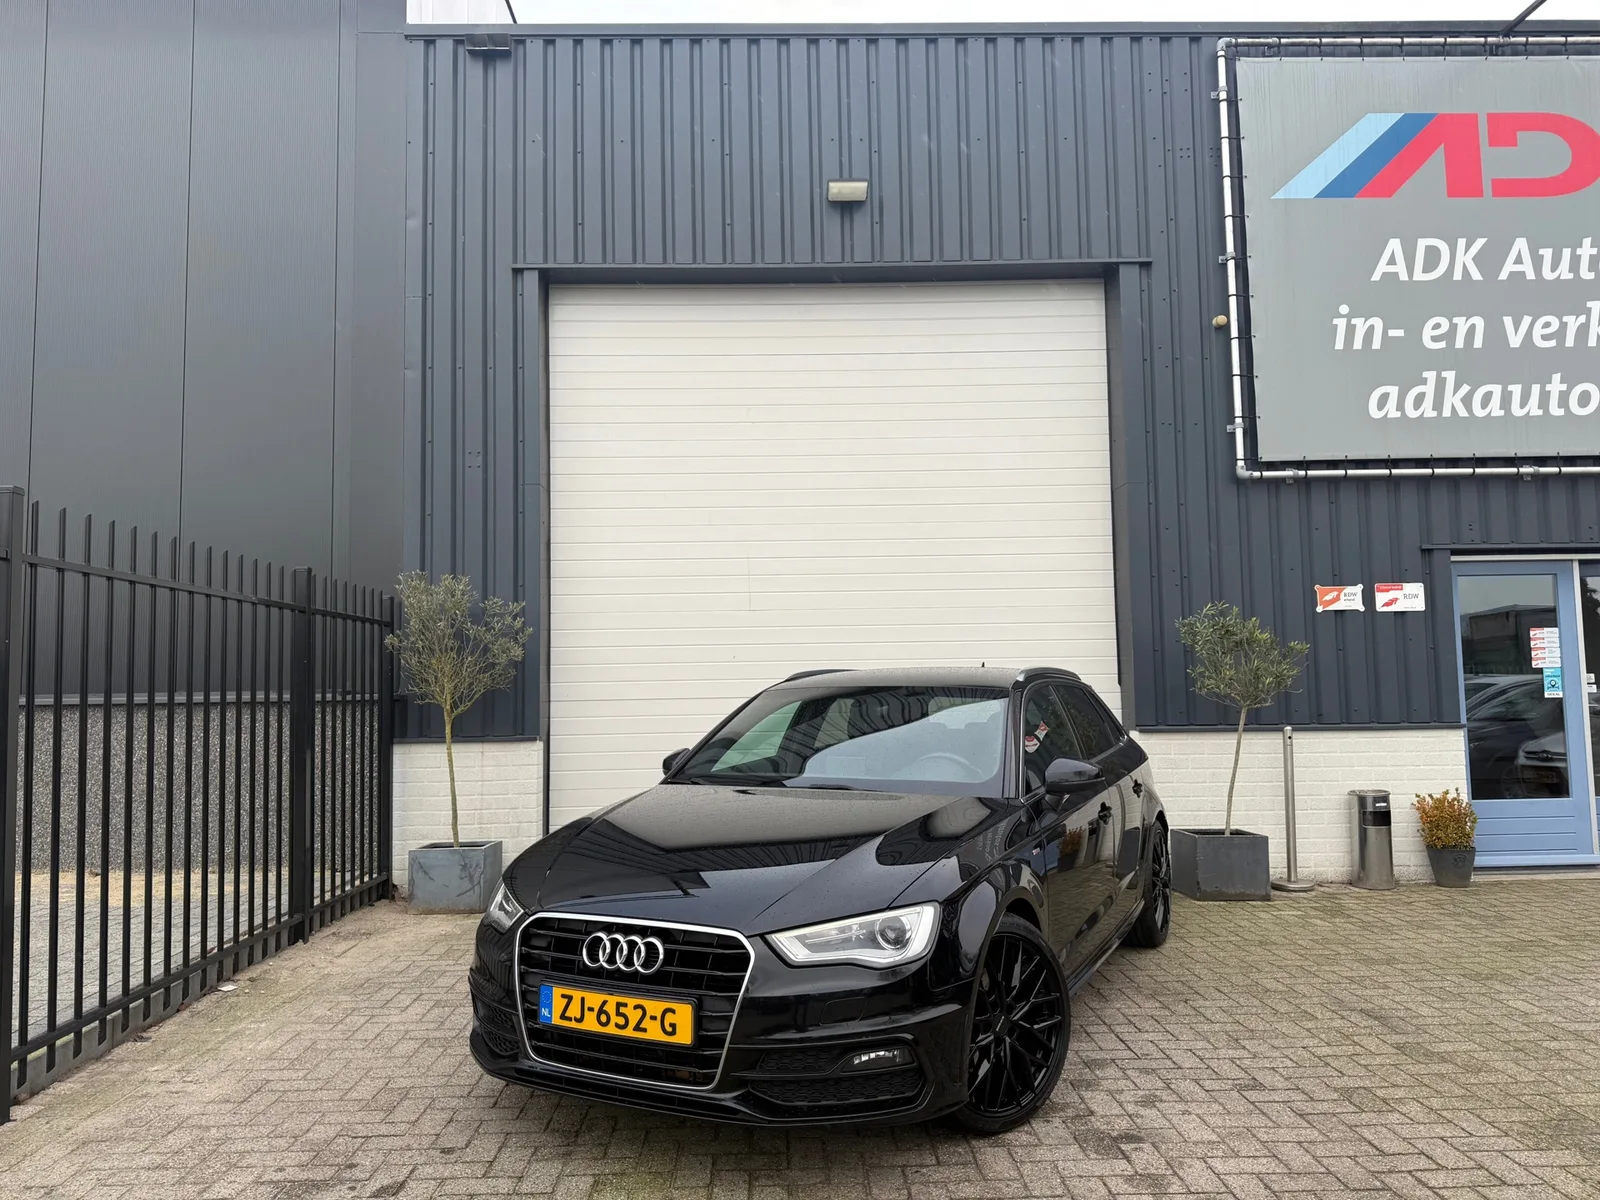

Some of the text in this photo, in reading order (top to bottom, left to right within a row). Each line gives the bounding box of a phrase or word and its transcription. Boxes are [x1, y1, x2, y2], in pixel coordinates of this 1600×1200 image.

[1370, 236, 1600, 282] ADK Aut
[1332, 303, 1405, 350] in-
[1421, 315, 1485, 350] en
[1368, 370, 1600, 419] adkauto
[541, 1007, 551, 1018] NL
[559, 993, 677, 1036] ZJ-652-G
